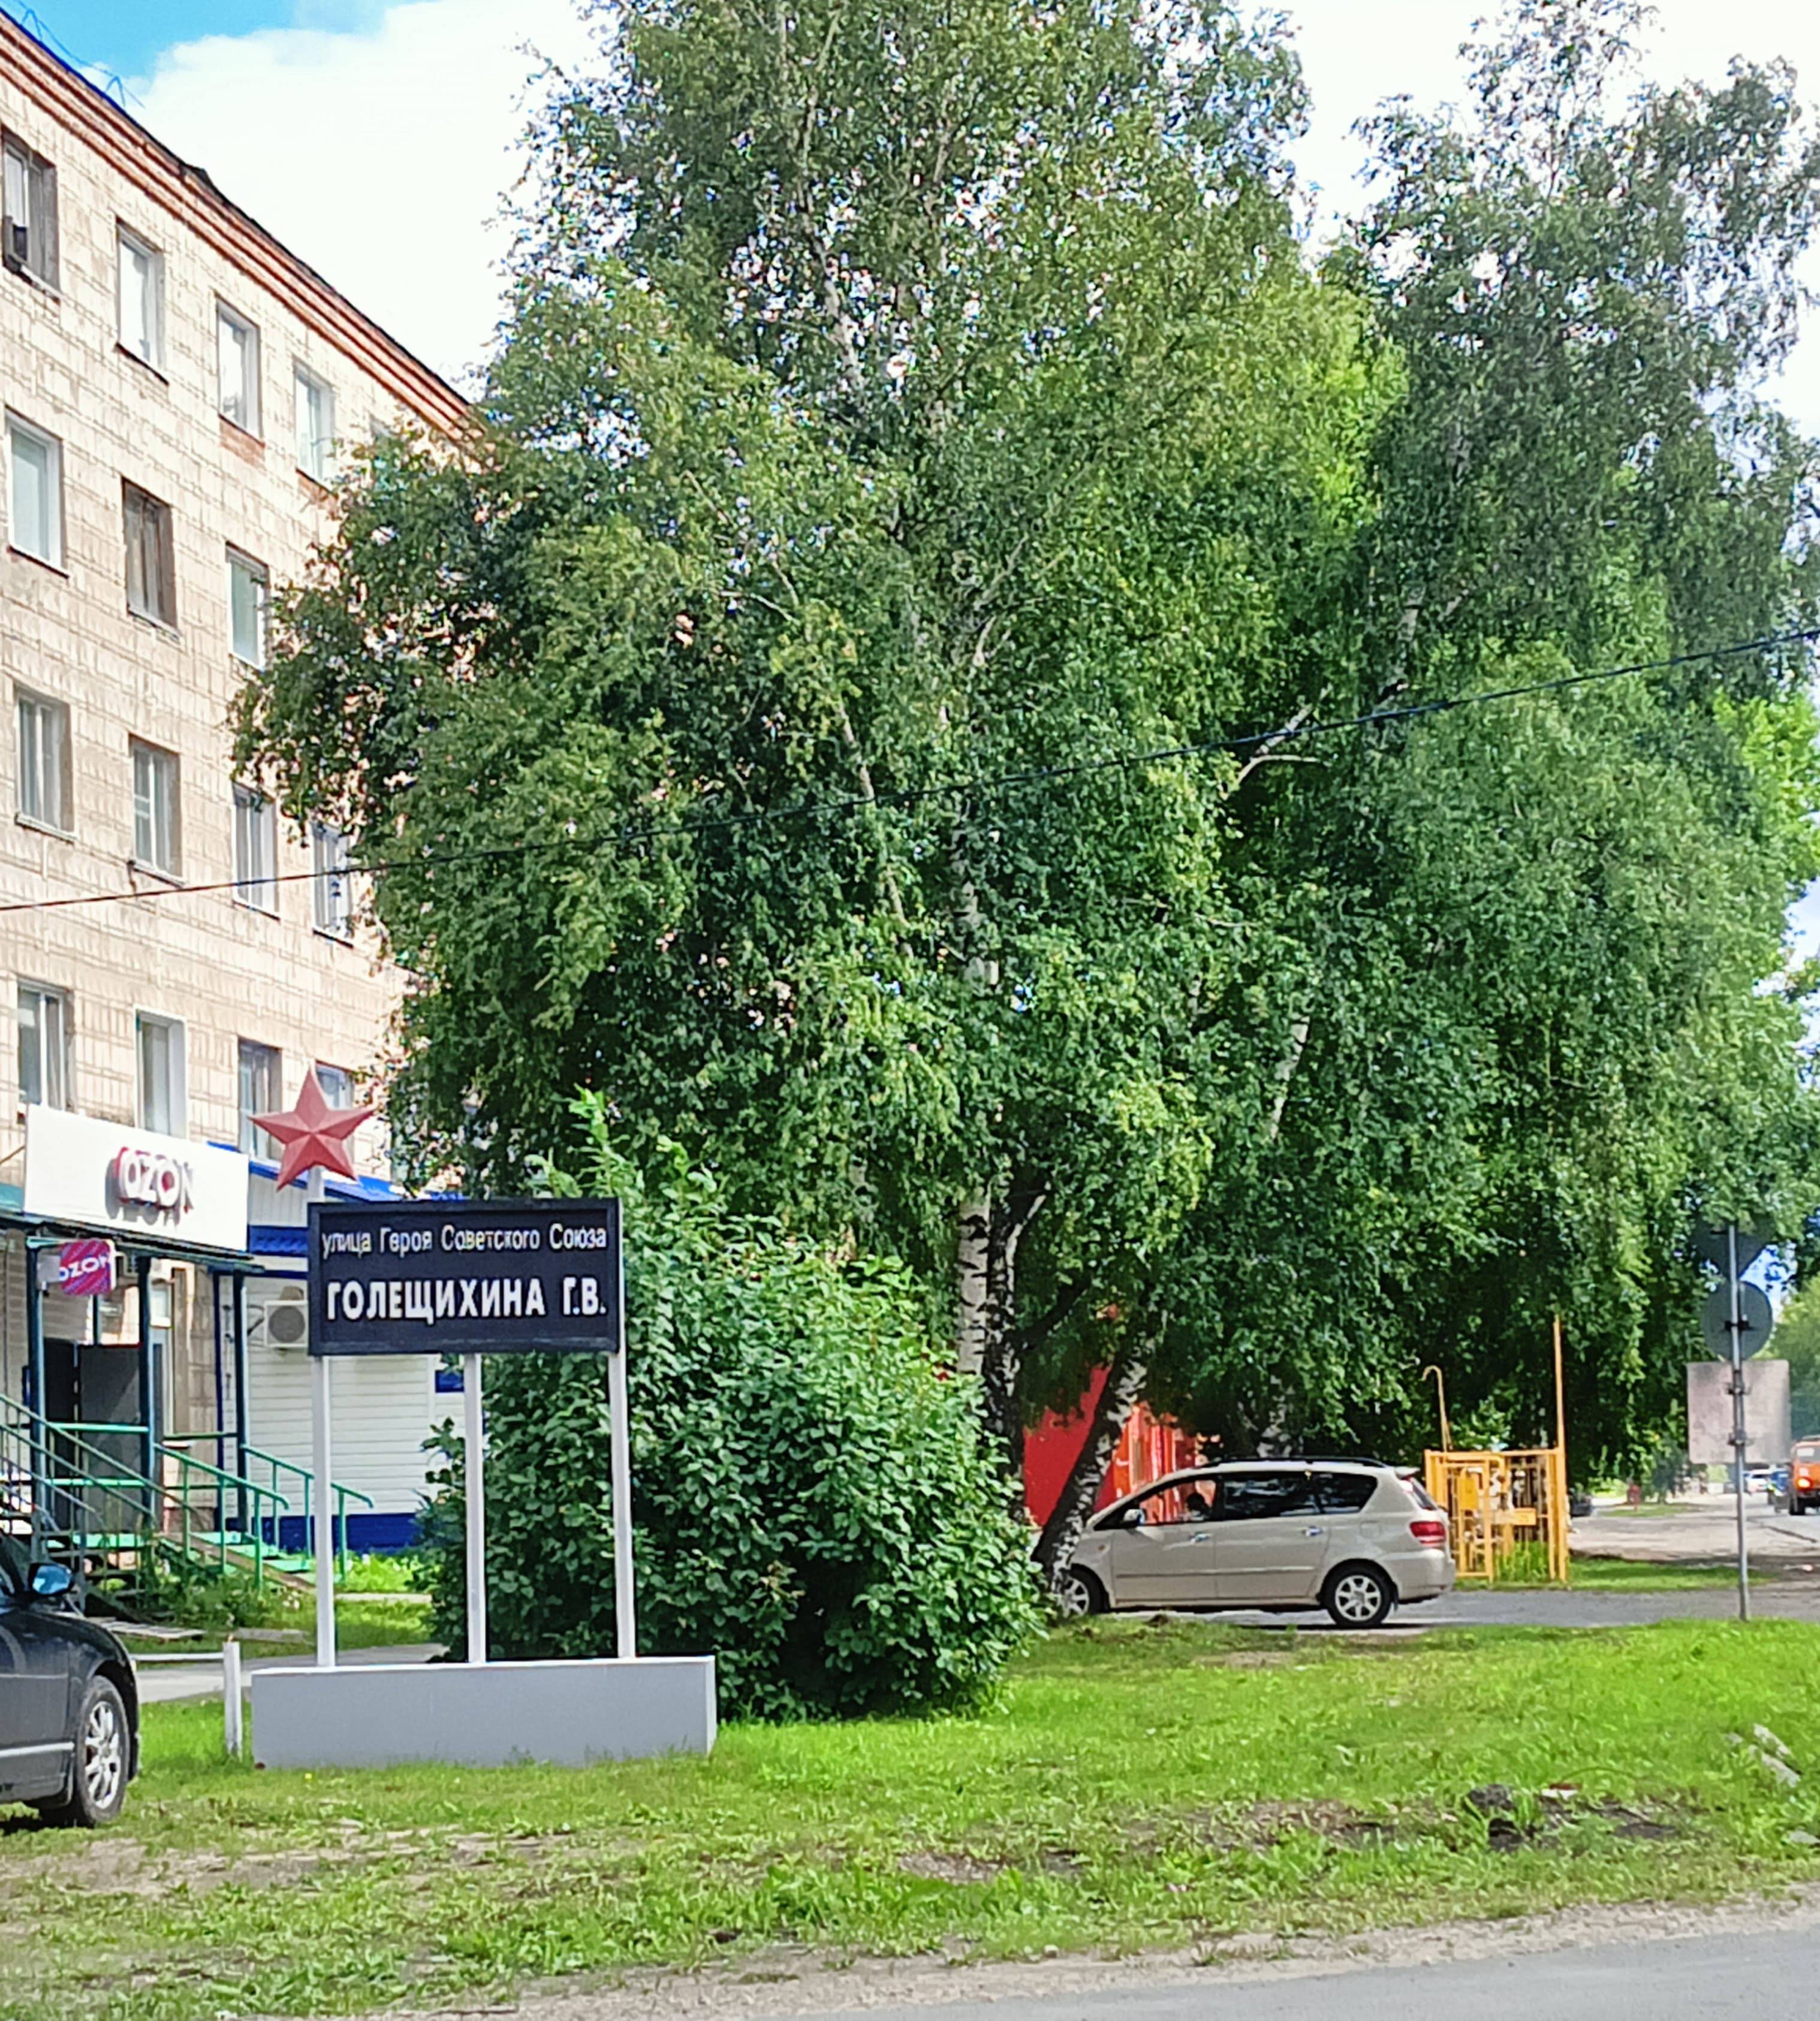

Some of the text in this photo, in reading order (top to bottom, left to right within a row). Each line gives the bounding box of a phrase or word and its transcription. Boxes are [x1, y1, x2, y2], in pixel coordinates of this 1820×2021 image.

[322, 1223, 607, 1257] улица Героя Советского Союза
[327, 1277, 607, 1324] ГОЛЕЩИХИНА Г.В.
